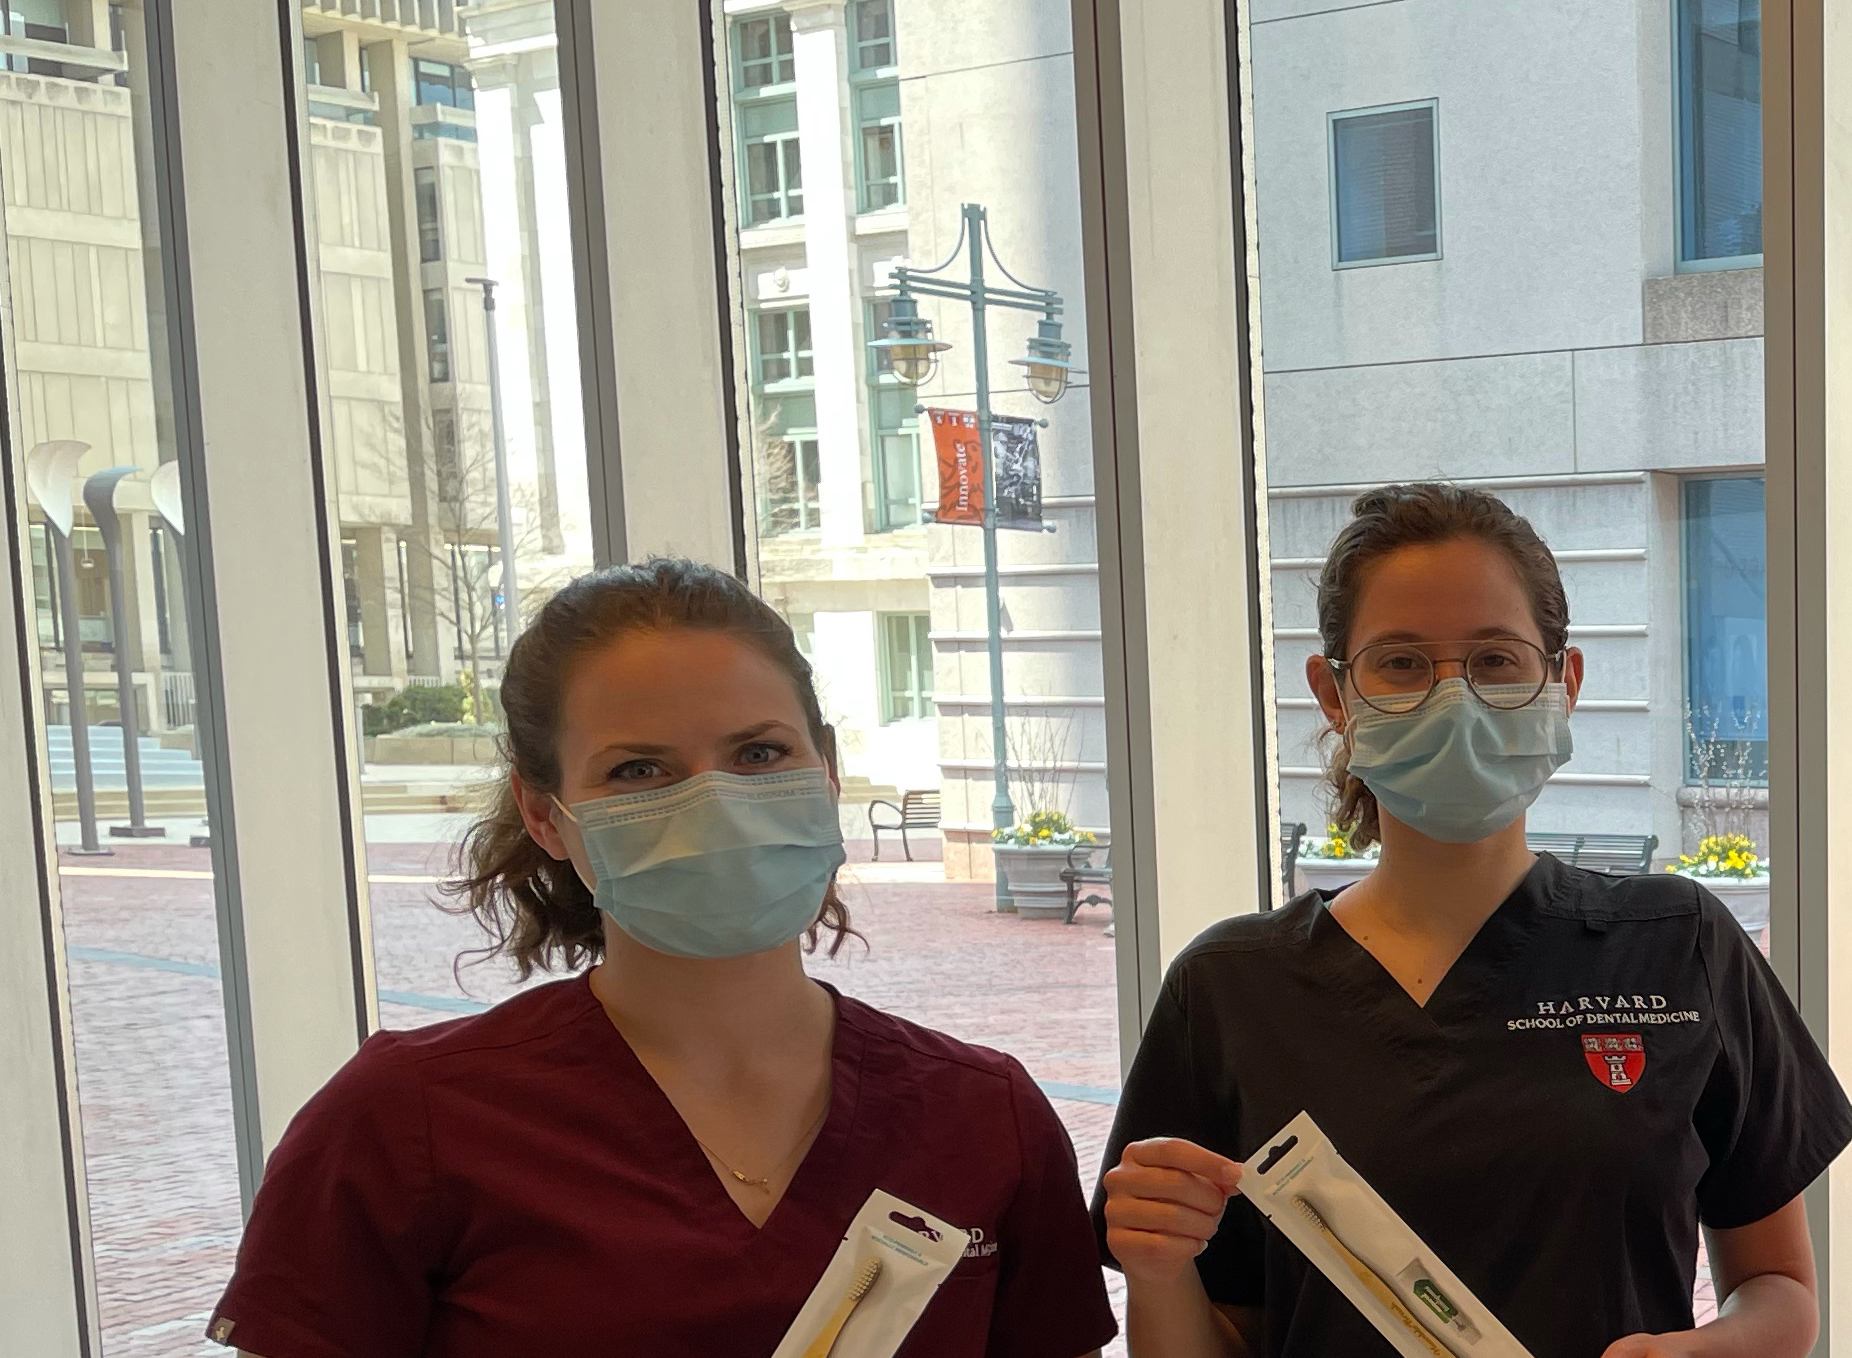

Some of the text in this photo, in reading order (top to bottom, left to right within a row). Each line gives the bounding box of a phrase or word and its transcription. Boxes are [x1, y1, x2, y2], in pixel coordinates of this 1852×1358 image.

[955, 442, 969, 511] Innovate
[1537, 994, 1667, 1015] HARVARD
[1507, 1010, 1700, 1031] SCHOOL OF DENTAL MEDICINE
